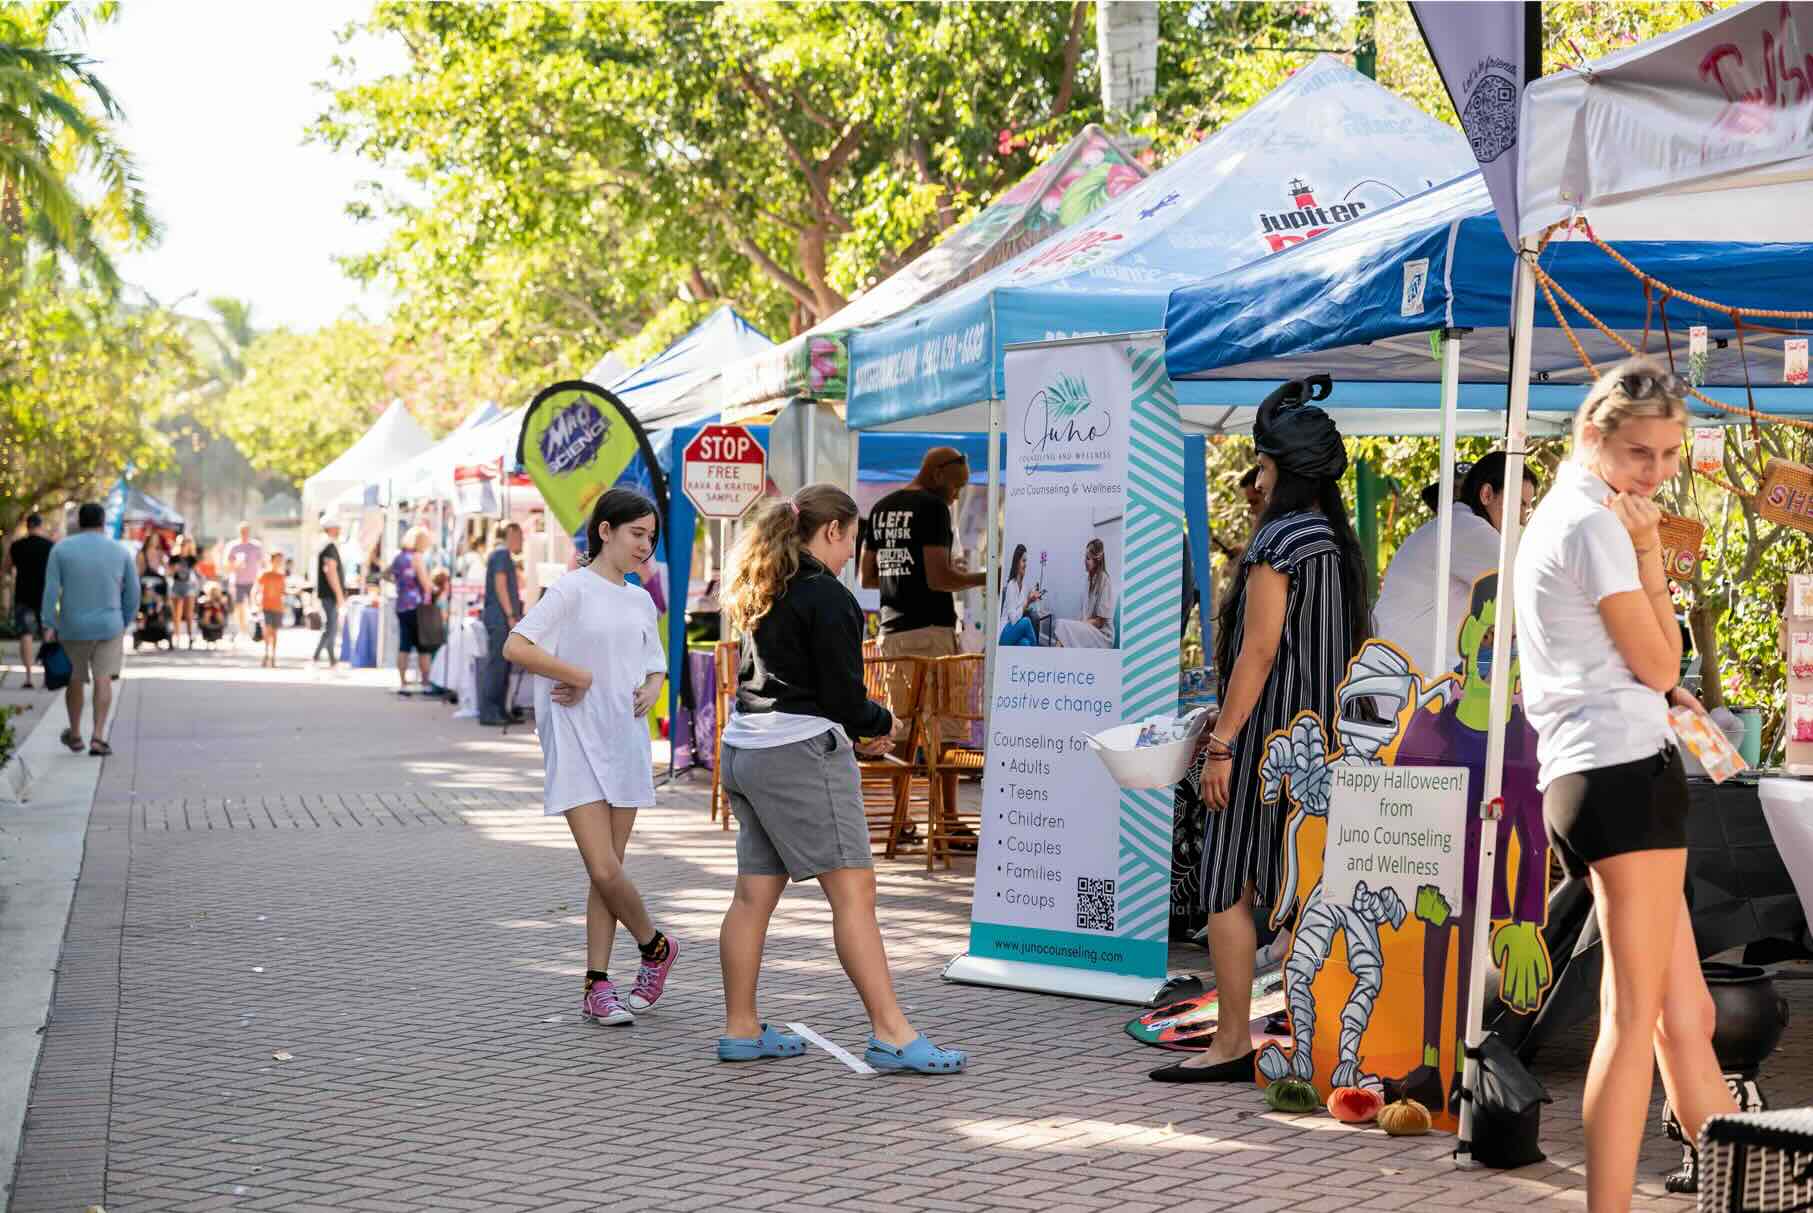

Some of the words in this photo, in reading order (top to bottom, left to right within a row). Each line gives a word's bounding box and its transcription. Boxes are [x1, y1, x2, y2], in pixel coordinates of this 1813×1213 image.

[1259, 201, 1367, 233] jupiter
[1023, 390, 1112, 453] Juno
[700, 436, 750, 460] STOP
[706, 465, 741, 480] FREE
[706, 492, 741, 502] SAMPLE
[1026, 483, 1070, 497] Counseling
[1071, 482, 1079, 494] &
[1081, 481, 1121, 494] Wellness
[878, 510, 914, 529] LEFT
[1010, 664, 1096, 687] Experience
[996, 692, 1050, 712] positive
[1054, 695, 1112, 717] change
[993, 730, 1064, 753] Counseling
[1069, 735, 1088, 752] for
[1009, 757, 1050, 776] Adults
[1008, 783, 1049, 801] Teens
[1336, 768, 1380, 793] Happy
[1384, 769, 1464, 792] Halloween!
[1379, 797, 1414, 817] from
[1007, 809, 1065, 829] Children
[1006, 836, 1062, 857] Couples
[1337, 825, 1370, 847] Juno
[1373, 826, 1452, 853] Counseling
[1006, 862, 1062, 882] Families
[1347, 853, 1373, 872] and
[1377, 854, 1440, 877] Wellness
[1005, 888, 1056, 911] Groups
[994, 938, 1125, 964] www.junocounseling.com
